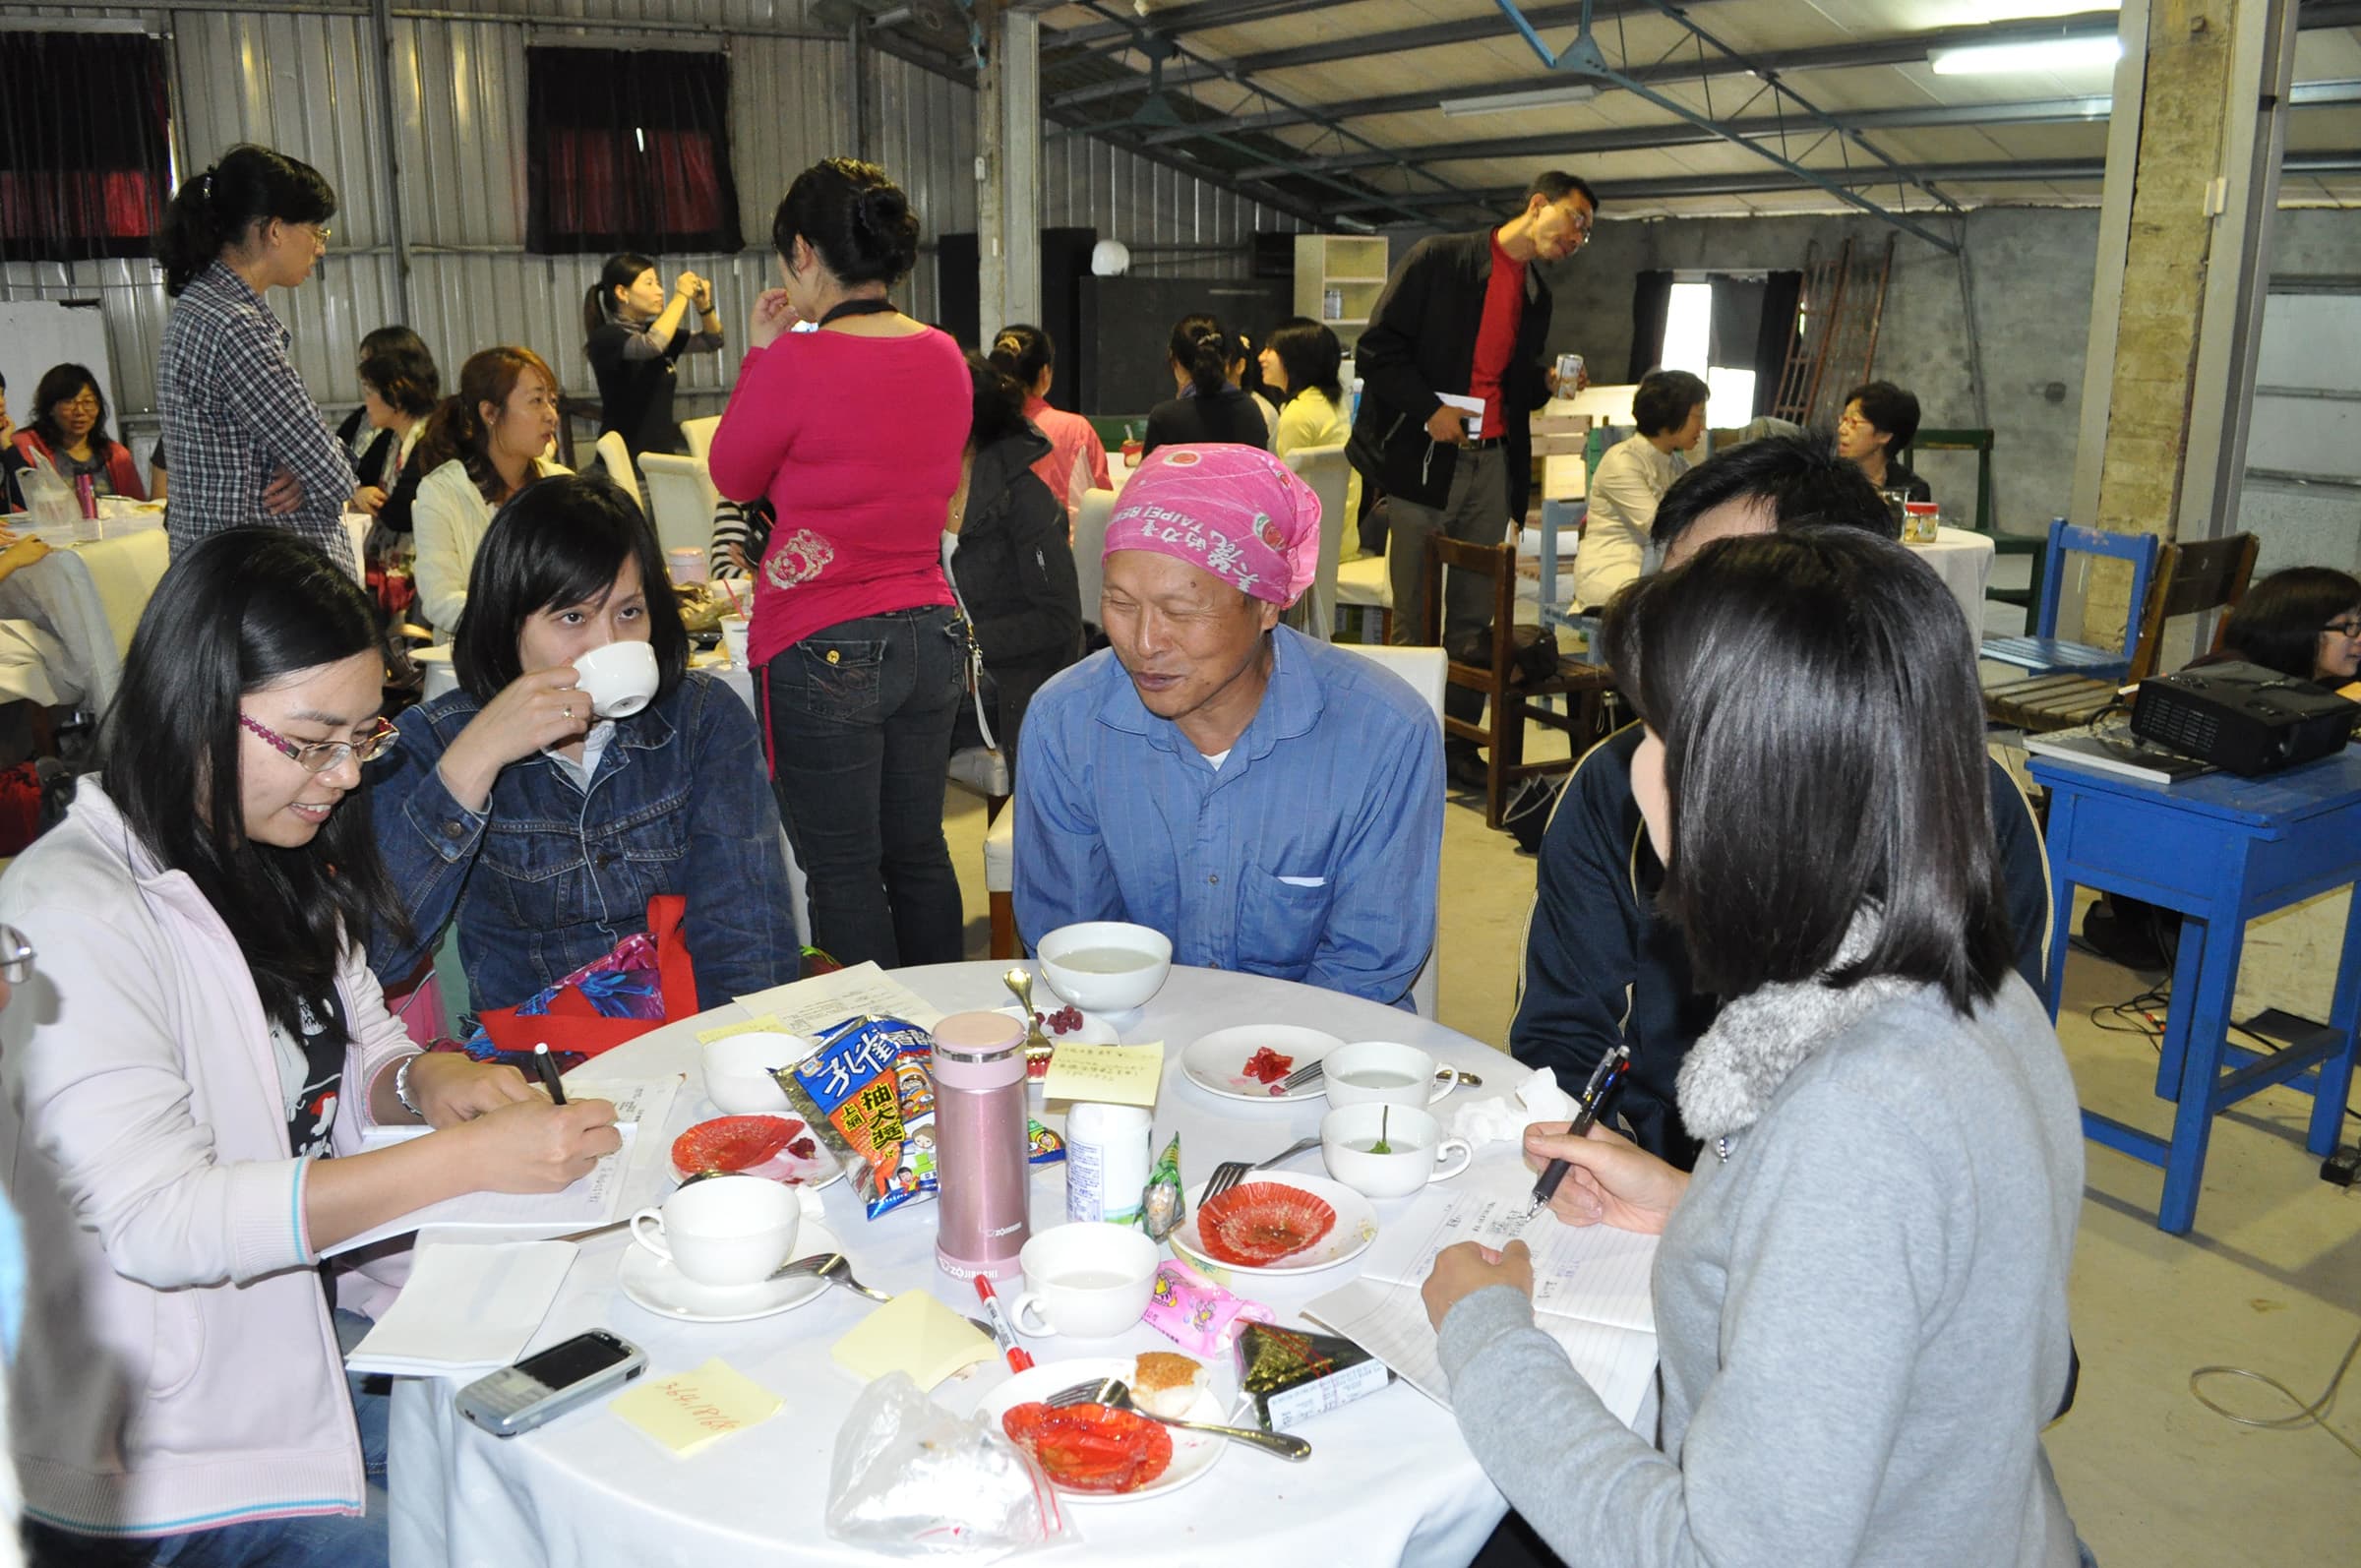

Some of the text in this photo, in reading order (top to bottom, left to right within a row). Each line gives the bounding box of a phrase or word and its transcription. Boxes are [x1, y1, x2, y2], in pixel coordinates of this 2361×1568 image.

[1143, 506, 1204, 532] TAIPEI
[841, 1104, 866, 1132] 上網
[860, 1083, 904, 1151] 抽大獎
